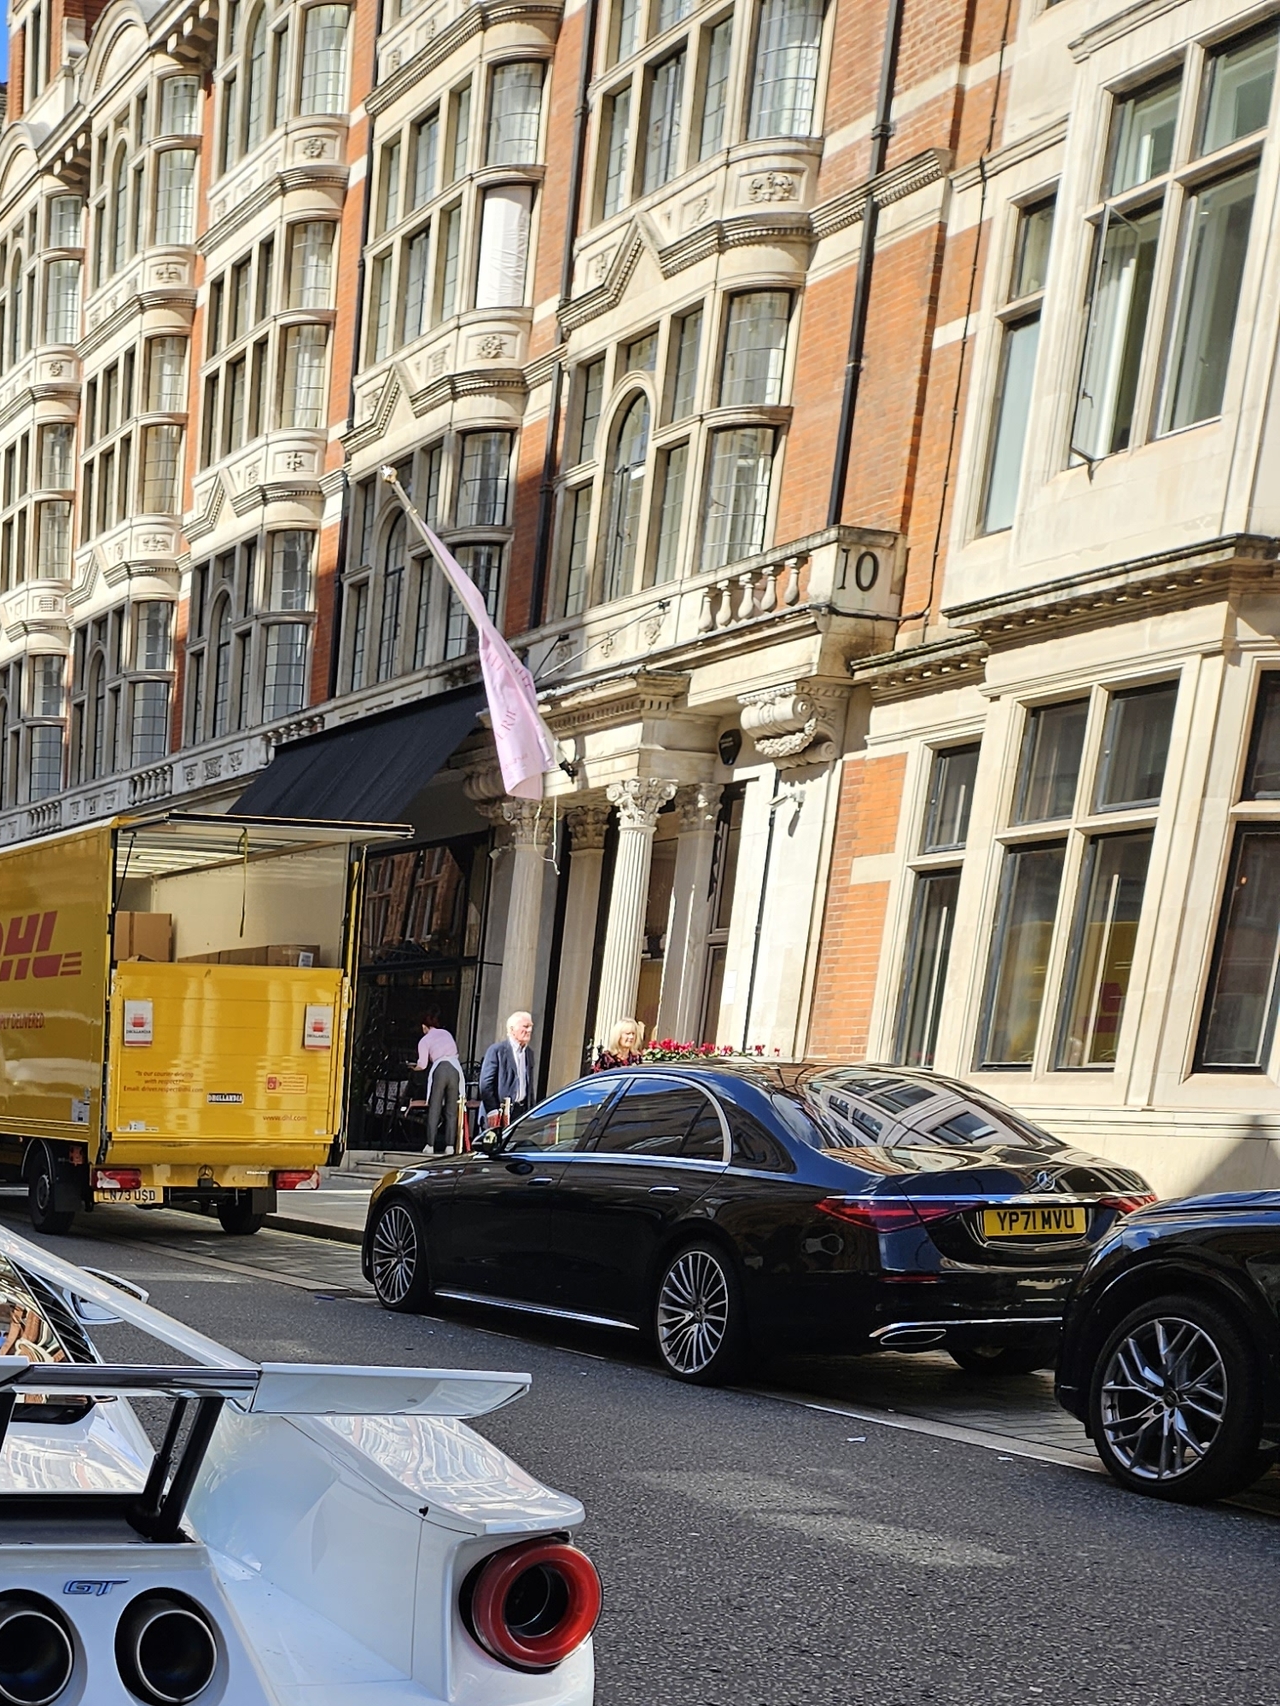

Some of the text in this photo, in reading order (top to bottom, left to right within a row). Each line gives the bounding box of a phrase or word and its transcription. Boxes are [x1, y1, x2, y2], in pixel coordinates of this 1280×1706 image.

[837, 548, 879, 592] 10
[102, 1189, 131, 1201] LN73
[996, 1209, 1075, 1231] YP71 MVU
[63, 1579, 130, 1597] GT
